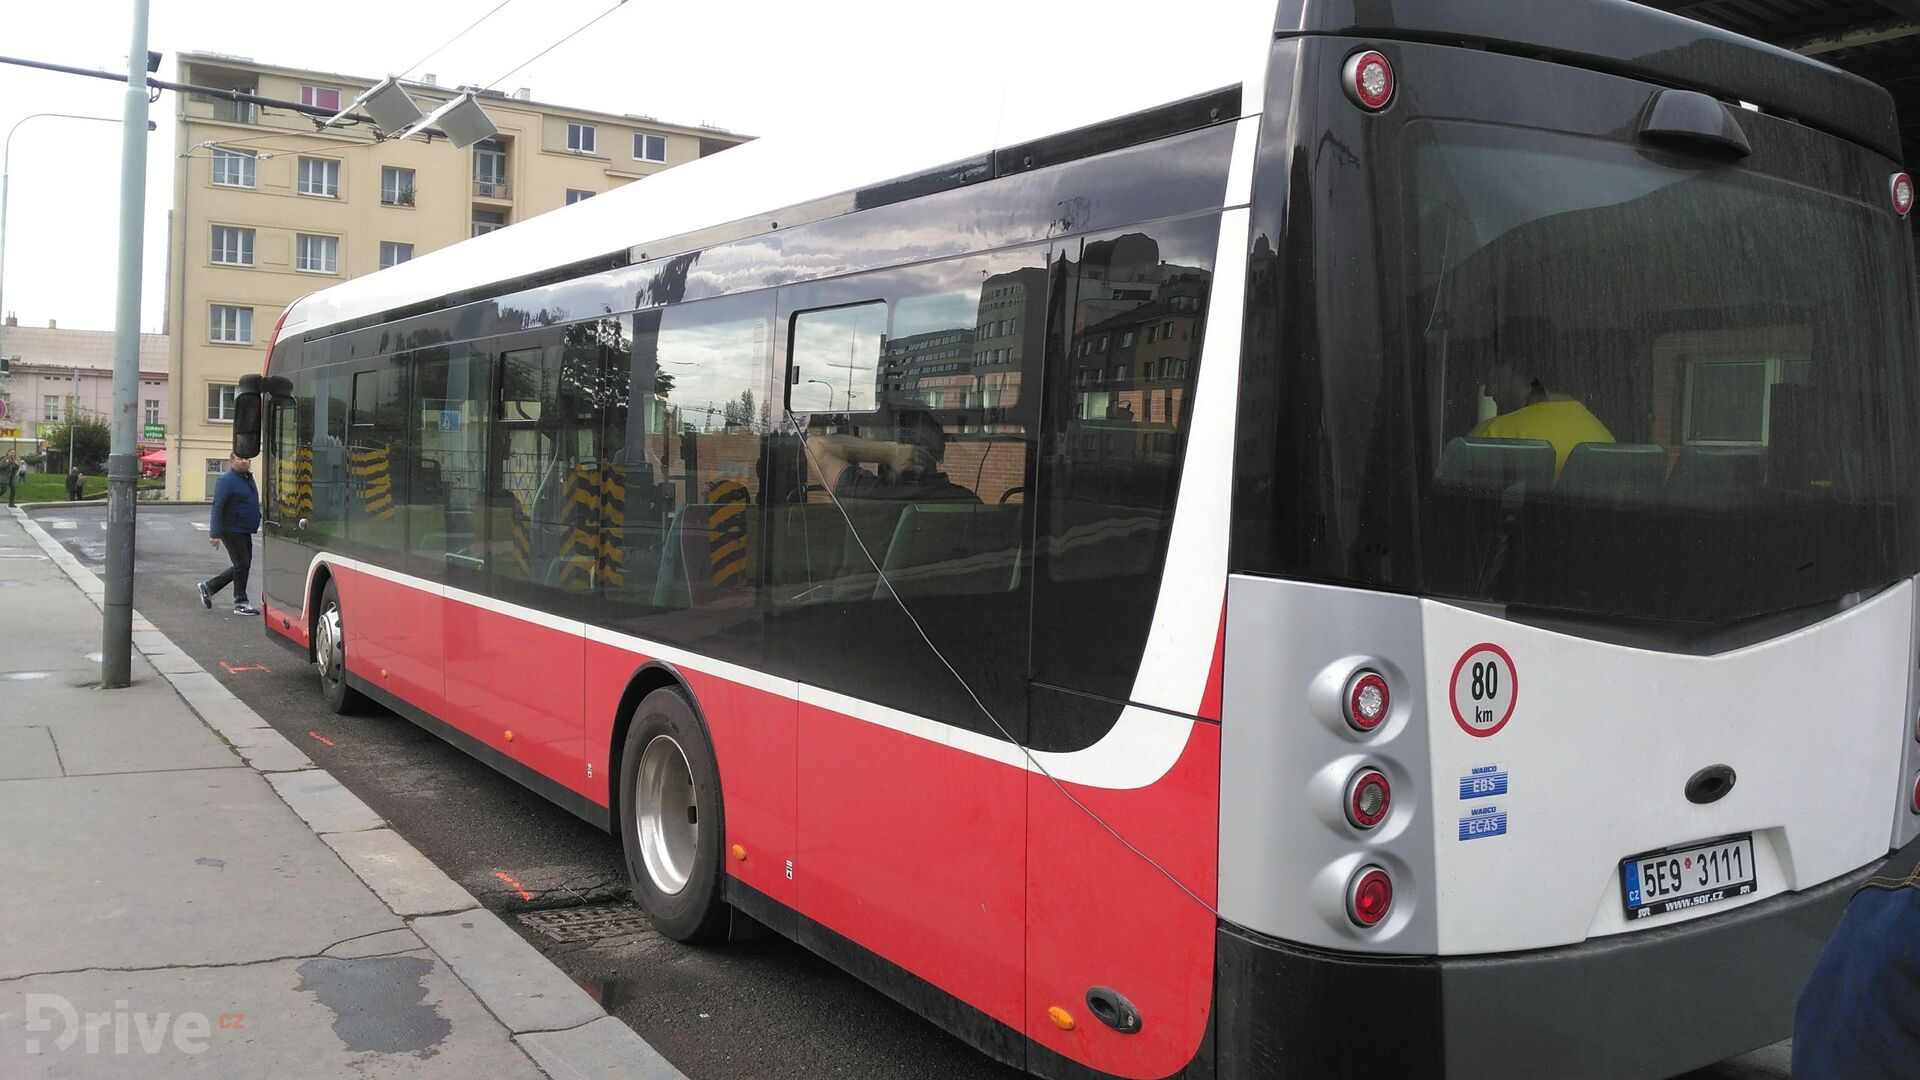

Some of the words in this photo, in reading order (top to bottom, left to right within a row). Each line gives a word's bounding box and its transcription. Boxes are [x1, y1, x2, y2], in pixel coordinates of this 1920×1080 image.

[1471, 661, 1498, 700] 80
[1475, 705, 1493, 723] km
[1472, 766, 1497, 775] WABCO
[1473, 778, 1496, 793] EBS
[1471, 806, 1496, 816] WABCO
[1469, 818, 1498, 835] ECAS
[1643, 859, 1682, 897] 5E9
[1697, 846, 1743, 886] 3111
[1628, 890, 1640, 901] CZ
[1665, 891, 1724, 912] www.sor.cz
